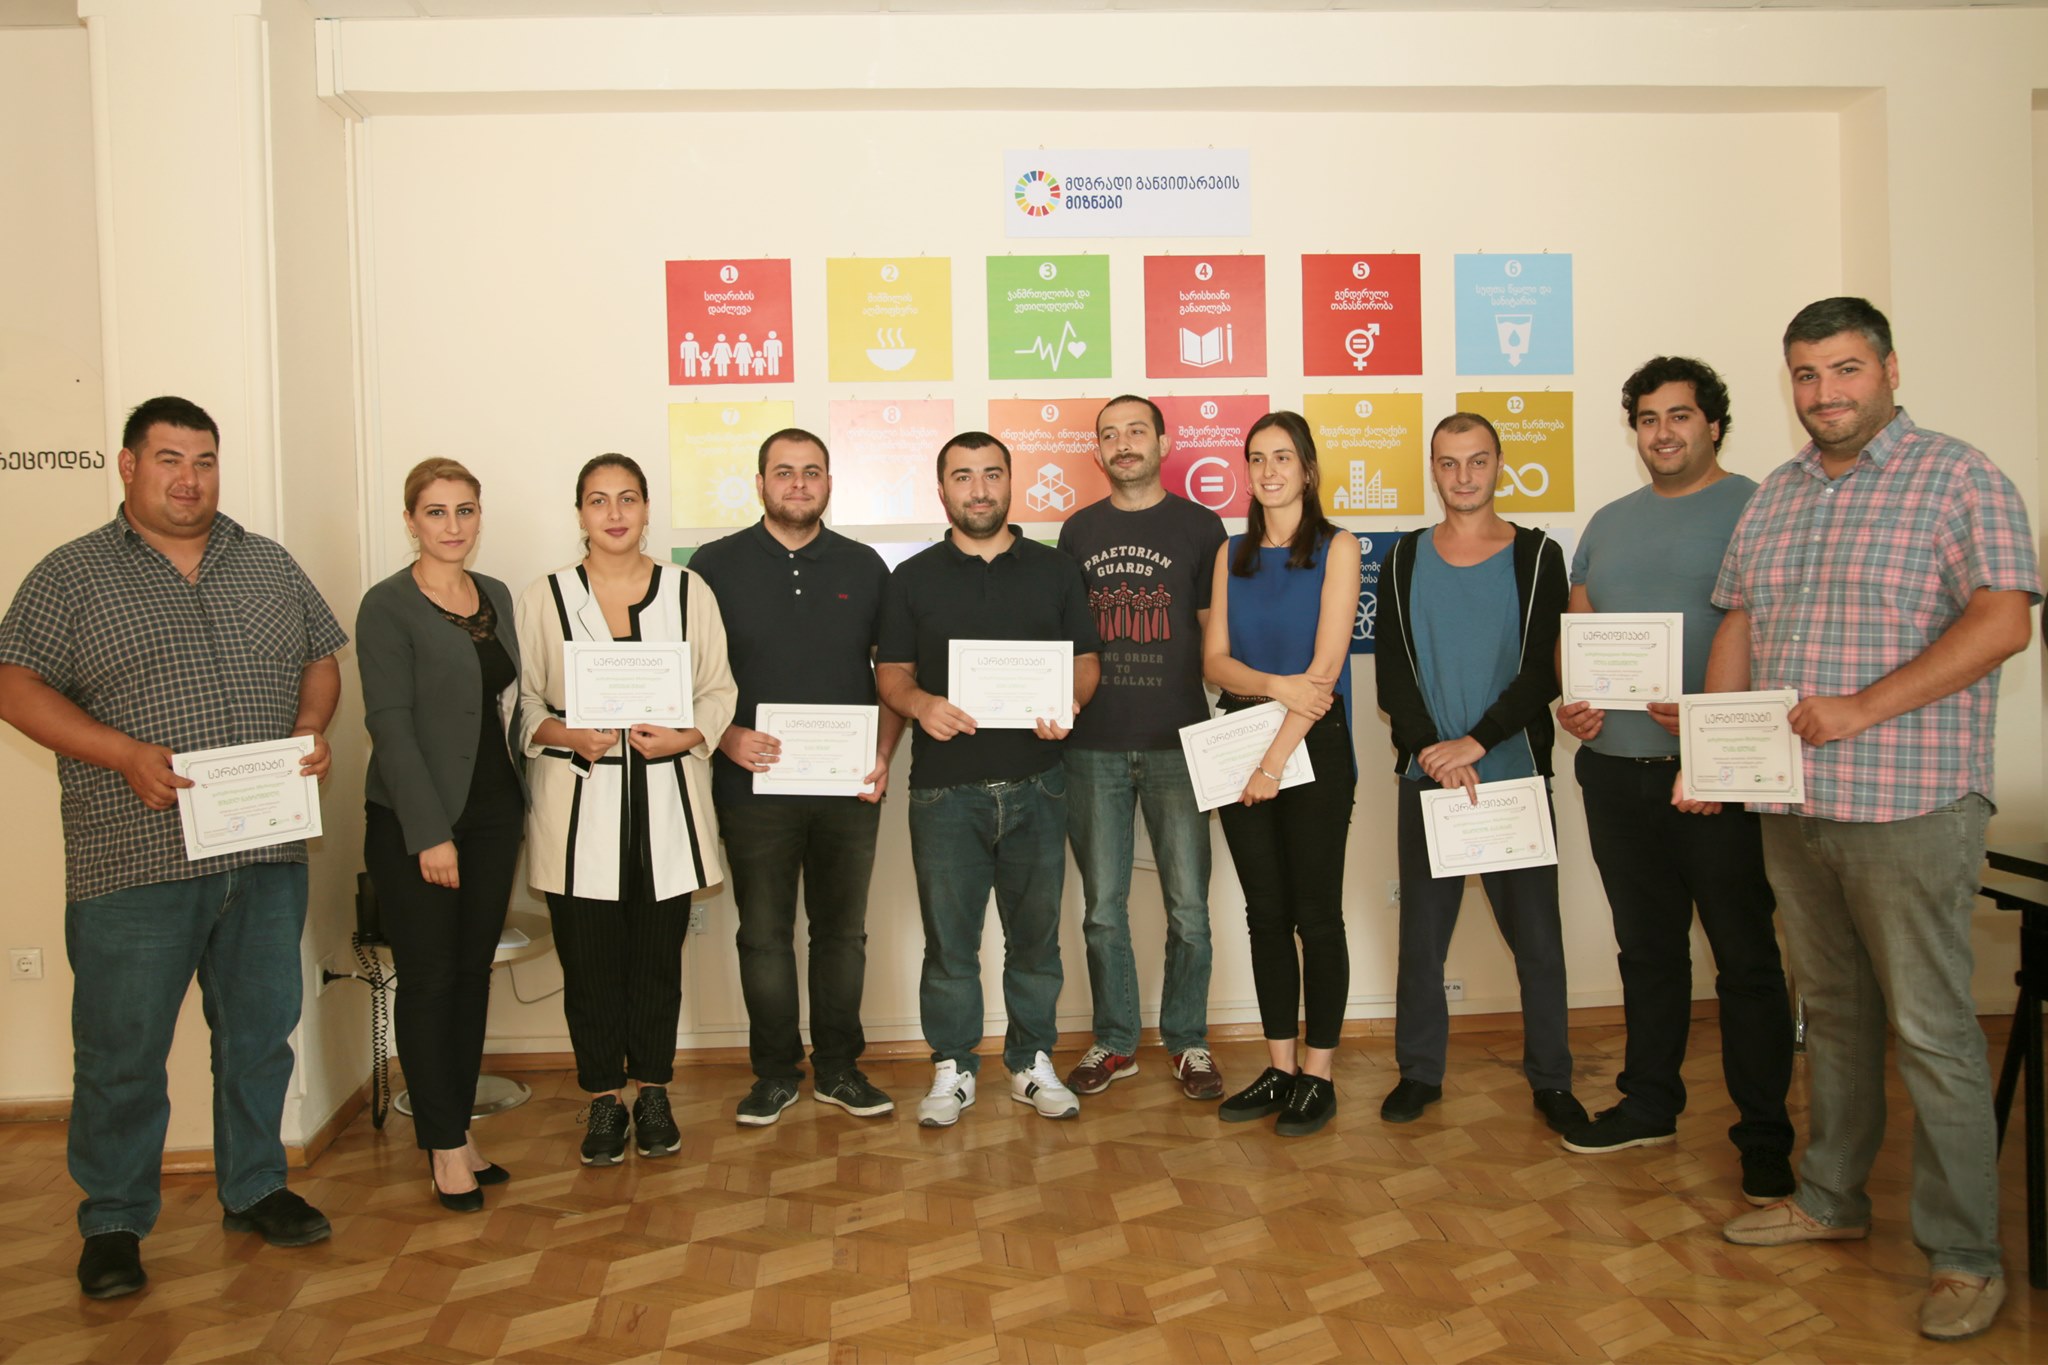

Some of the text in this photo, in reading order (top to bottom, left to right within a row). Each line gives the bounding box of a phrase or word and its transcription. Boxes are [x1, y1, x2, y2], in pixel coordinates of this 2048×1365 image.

[1065, 175, 1240, 191] მდგრადი განვითარების
[1065, 194, 1123, 210] მიზნები
[704, 290, 755, 303] სიღარიბის
[1007, 288, 1091, 301] ჯანმრთელობა და
[1179, 290, 1231, 301] ხარისხიანი
[1334, 288, 1389, 301] გენდერული
[708, 303, 752, 315] დაძლევა
[1179, 302, 1232, 315] განათლება
[1330, 300, 1394, 311] თანასწორობა
[1000, 428, 1055, 441] ინდუსტრია,
[1177, 425, 1241, 438] შემცირებული
[1175, 437, 1245, 451] უთანასწორობა
[1084, 545, 1172, 572] PRAETORIAN
[1097, 562, 1154, 578] GUARDS
[1583, 631, 1650, 641] სერტიფიკატი
[593, 657, 663, 667] სერტიფიკატი
[977, 656, 1046, 666] სერტიფიკატი
[1124, 652, 1164, 664] ORDER
[1115, 664, 1130, 673] TO
[1113, 675, 1163, 687] GALAXY
[785, 719, 851, 729] სერტიფიკატი
[1704, 712, 1772, 725] სერტიფიკატი
[207, 758, 285, 780] სერტიფიკატი
